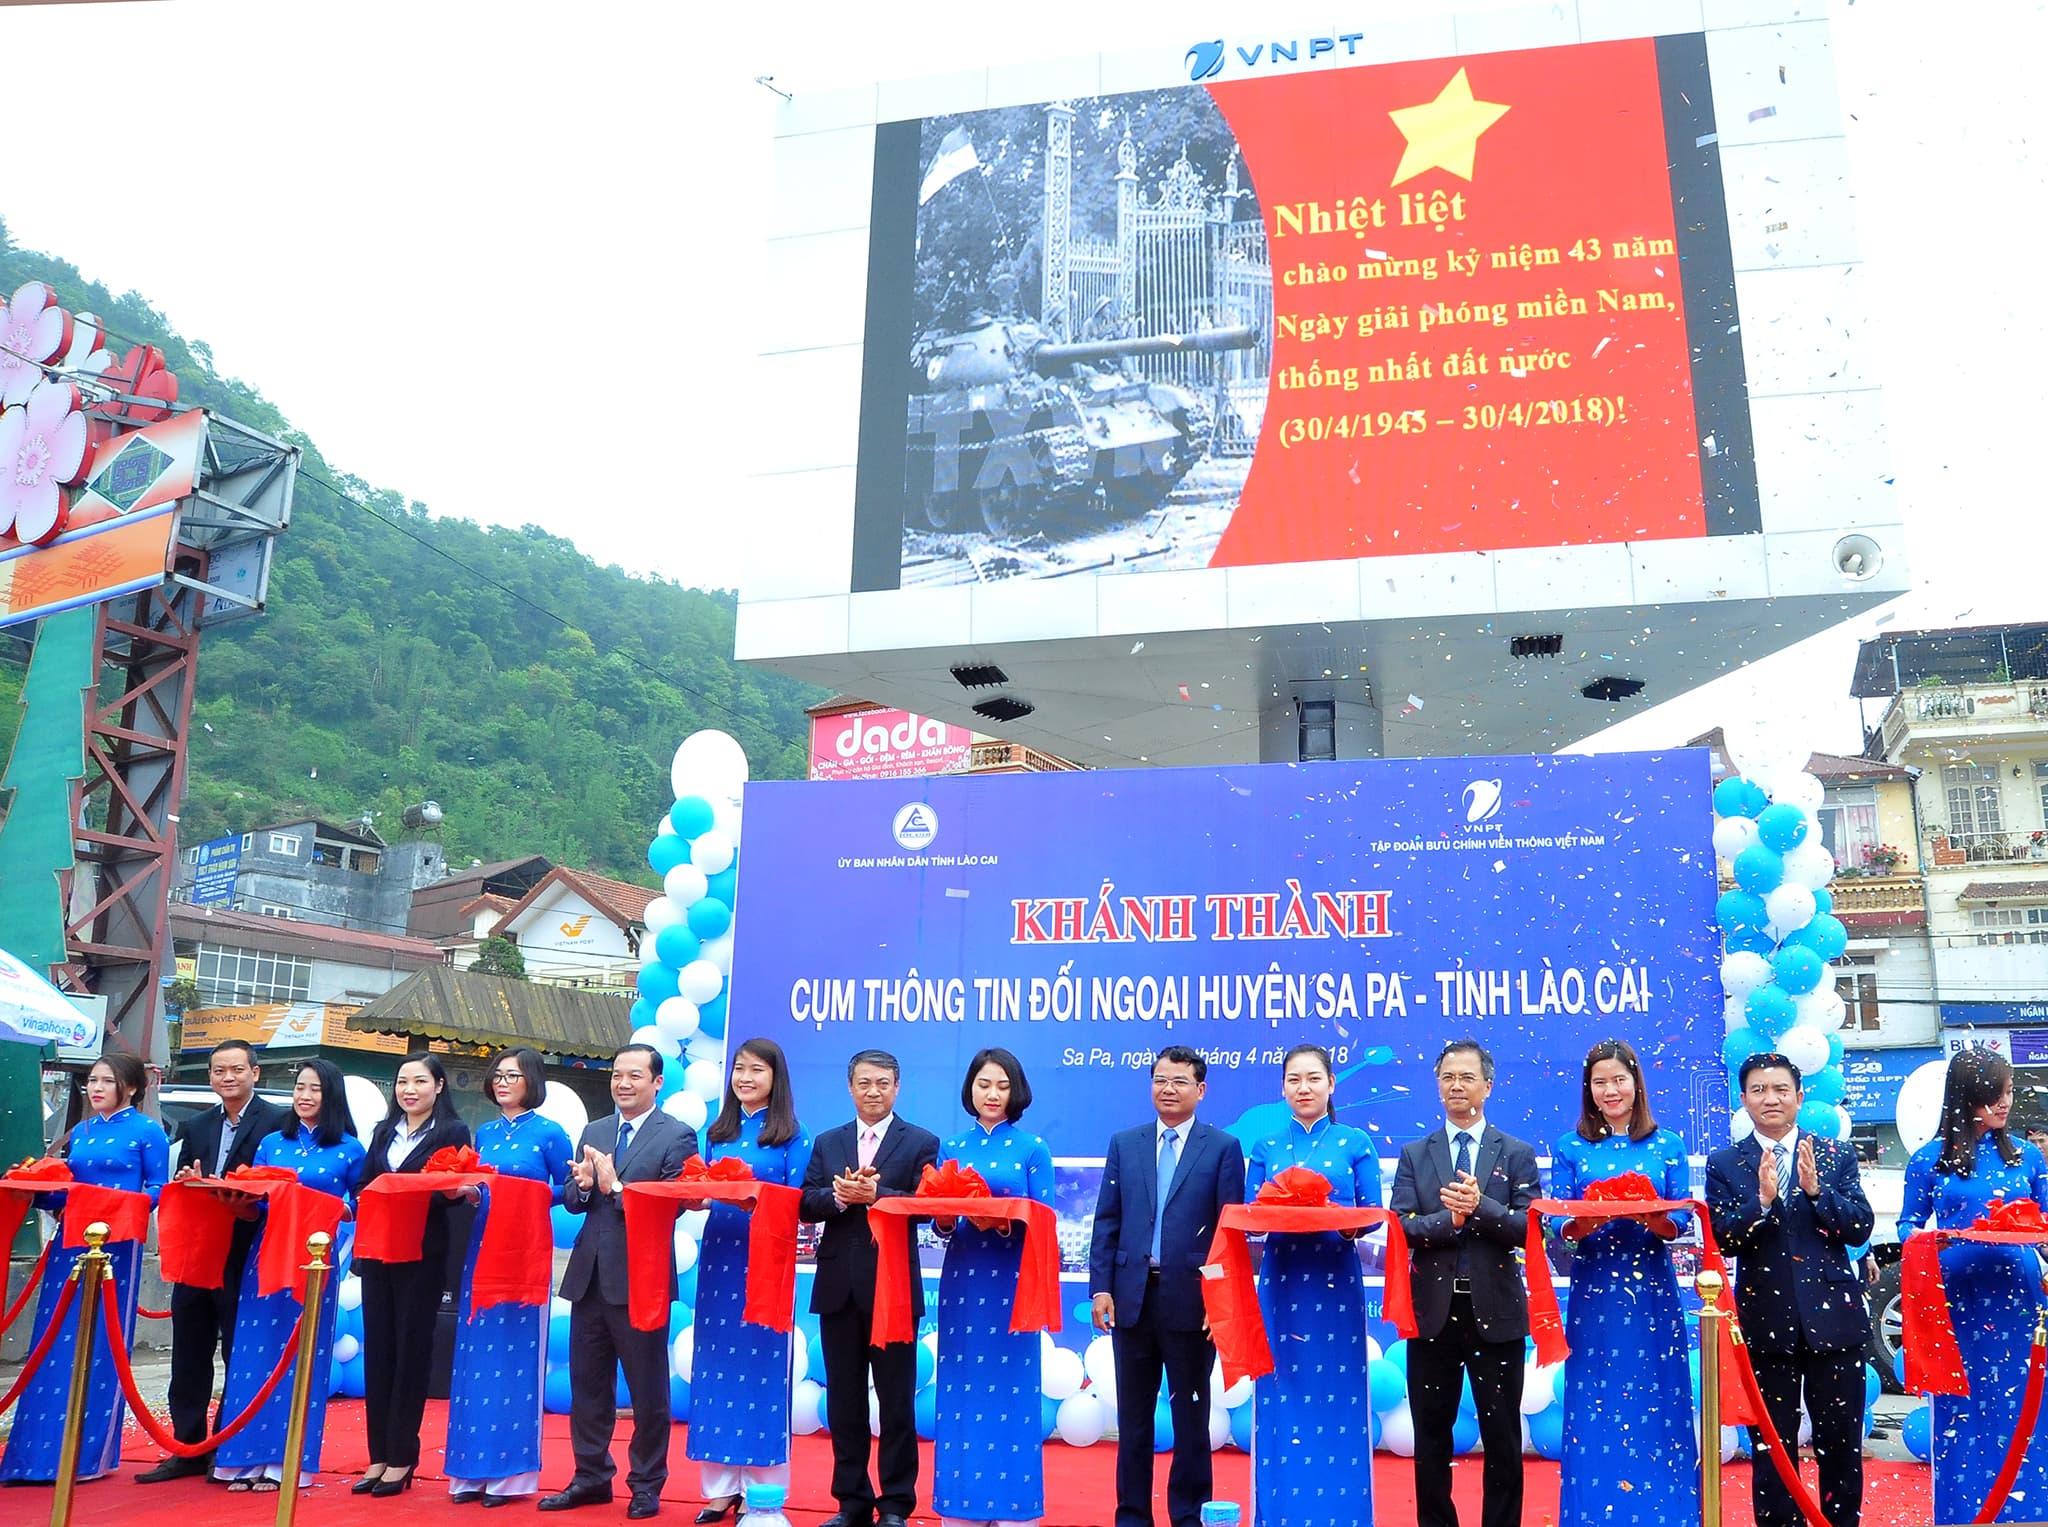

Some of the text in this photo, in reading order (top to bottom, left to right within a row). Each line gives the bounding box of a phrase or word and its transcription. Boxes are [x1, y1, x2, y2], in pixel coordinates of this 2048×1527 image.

[1237, 33, 1364, 66] VNPT
[1273, 189, 1466, 239] Nhiệt liệt
[1283, 236, 1676, 286] chào mừng kỷ niệm 43 năm
[1276, 288, 1676, 342] Ngày giải phóng miền Nam,
[1278, 347, 1571, 391] thống nhất đất nước
[1279, 410, 1427, 449] (30/4/1945
[1463, 396, 1625, 432] 30/4/2018)!
[836, 713, 947, 757] dada
[1464, 823, 1503, 833] VNPT
[1371, 840, 1391, 852] TẬP
[1394, 839, 1423, 851] ĐOÀN
[1427, 840, 1450, 851] BƯU
[1453, 838, 1486, 849] CHÍNH
[1515, 836, 1552, 848] THÔNG
[1555, 835, 1578, 849] VIỆT
[1581, 836, 1605, 846] NAM
[854, 859, 874, 867] BAN
[877, 856, 904, 867] NHÂN
[908, 856, 928, 866] DÂN
[957, 854, 978, 865] LÀO
[981, 855, 998, 864] CAI
[1010, 879, 1393, 944] KHÁNH THÀNH
[791, 979, 856, 1030] CỤM
[864, 968, 965, 1022] THÔNG
[974, 978, 1020, 1021] TIN
[1029, 960, 1081, 1021] ĐỐI
[1092, 976, 1188, 1029] NGOẠI
[1200, 962, 1306, 1028] HUYỆN
[1316, 973, 1358, 1017] SA
[1367, 973, 1408, 1017] PA
[1436, 958, 1509, 1017] TỈNH
[1518, 958, 1584, 1015] LÀO
[1594, 966, 1650, 1013] CAI
[239, 1013, 256, 1021] NAM
[2020, 1004, 2045, 1018] NGÂN
[22, 1016, 71, 1037] vinaphone
[1062, 1048, 1084, 1066] Sa
[1089, 1048, 1115, 1069] Pa,
[1246, 1048, 1257, 1064] 4
[1262, 1047, 1287, 1065] nă
[1846, 1074, 1870, 1083] UỐC
[1850, 1062, 1882, 1074] 29
